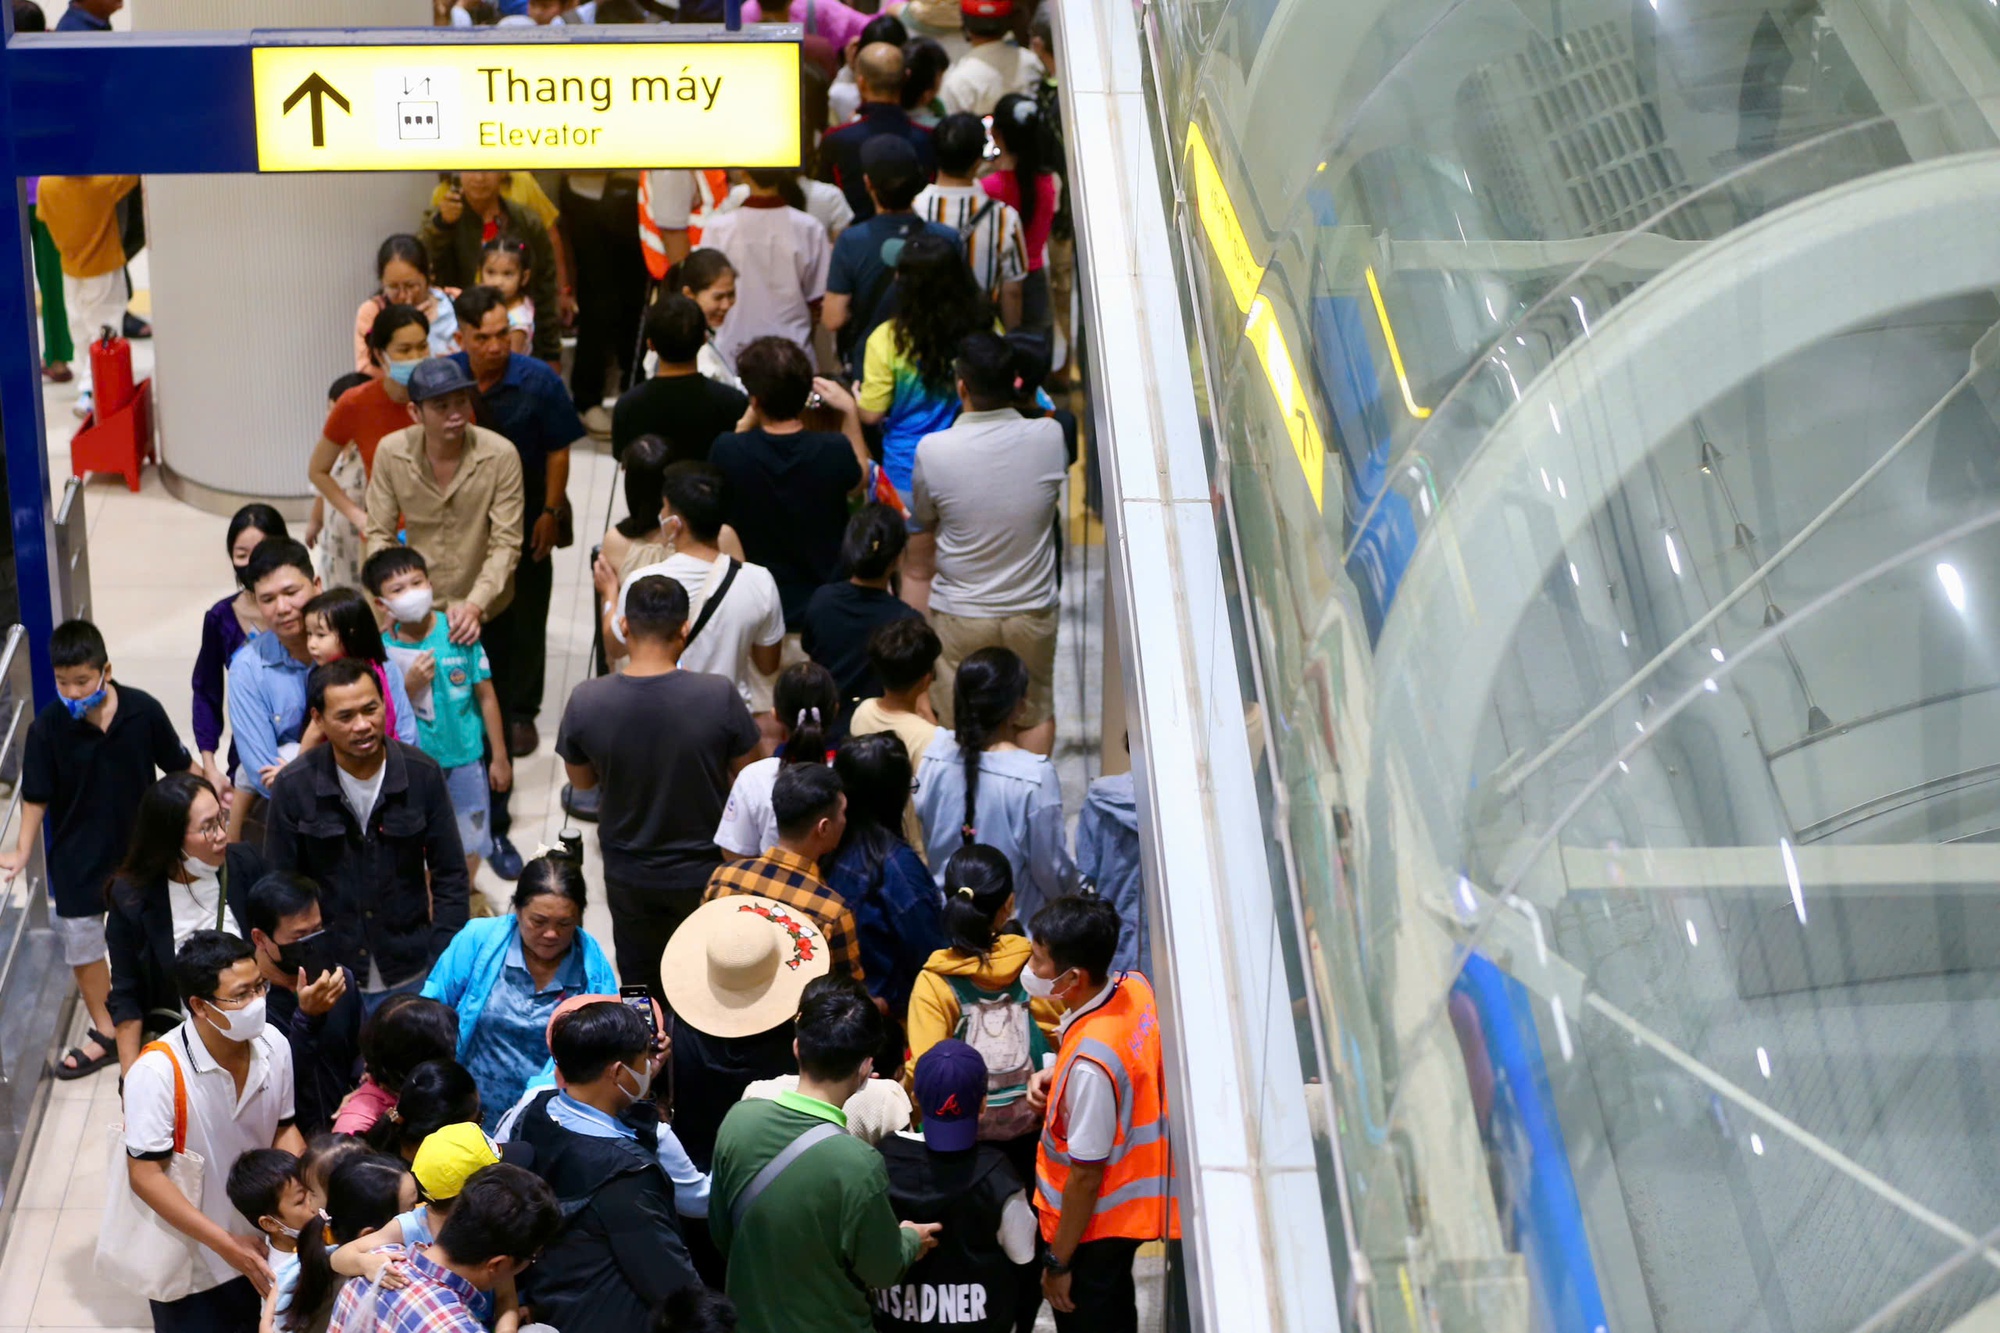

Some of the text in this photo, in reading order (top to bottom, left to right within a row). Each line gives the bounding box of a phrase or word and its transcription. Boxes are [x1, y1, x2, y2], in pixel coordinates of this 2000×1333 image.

[477, 66, 722, 112] Thang máy
[479, 122, 603, 146] Elevator
